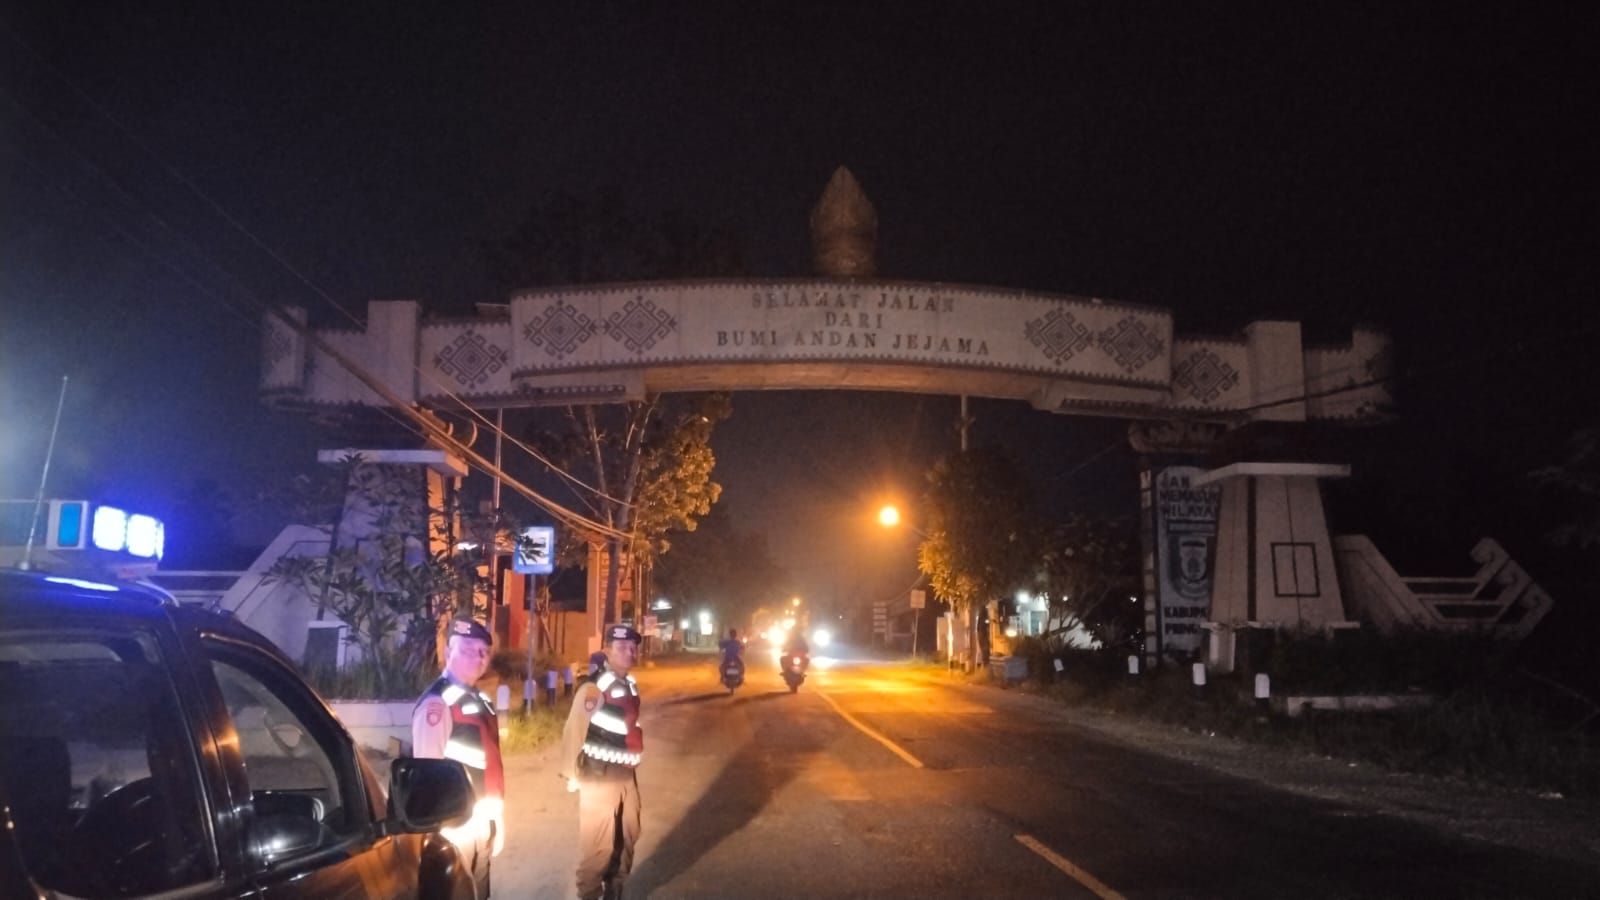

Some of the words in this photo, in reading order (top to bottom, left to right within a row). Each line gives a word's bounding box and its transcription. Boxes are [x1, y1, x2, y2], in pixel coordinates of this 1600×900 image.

[752, 292, 861, 309] SELAMAT
[878, 294, 954, 312] JALAN
[825, 311, 883, 329] DARI
[717, 331, 778, 346] BUMI
[794, 331, 877, 348] ANDAN
[893, 335, 989, 355] JEJAMA
[1164, 606, 1208, 618] KABUPA
